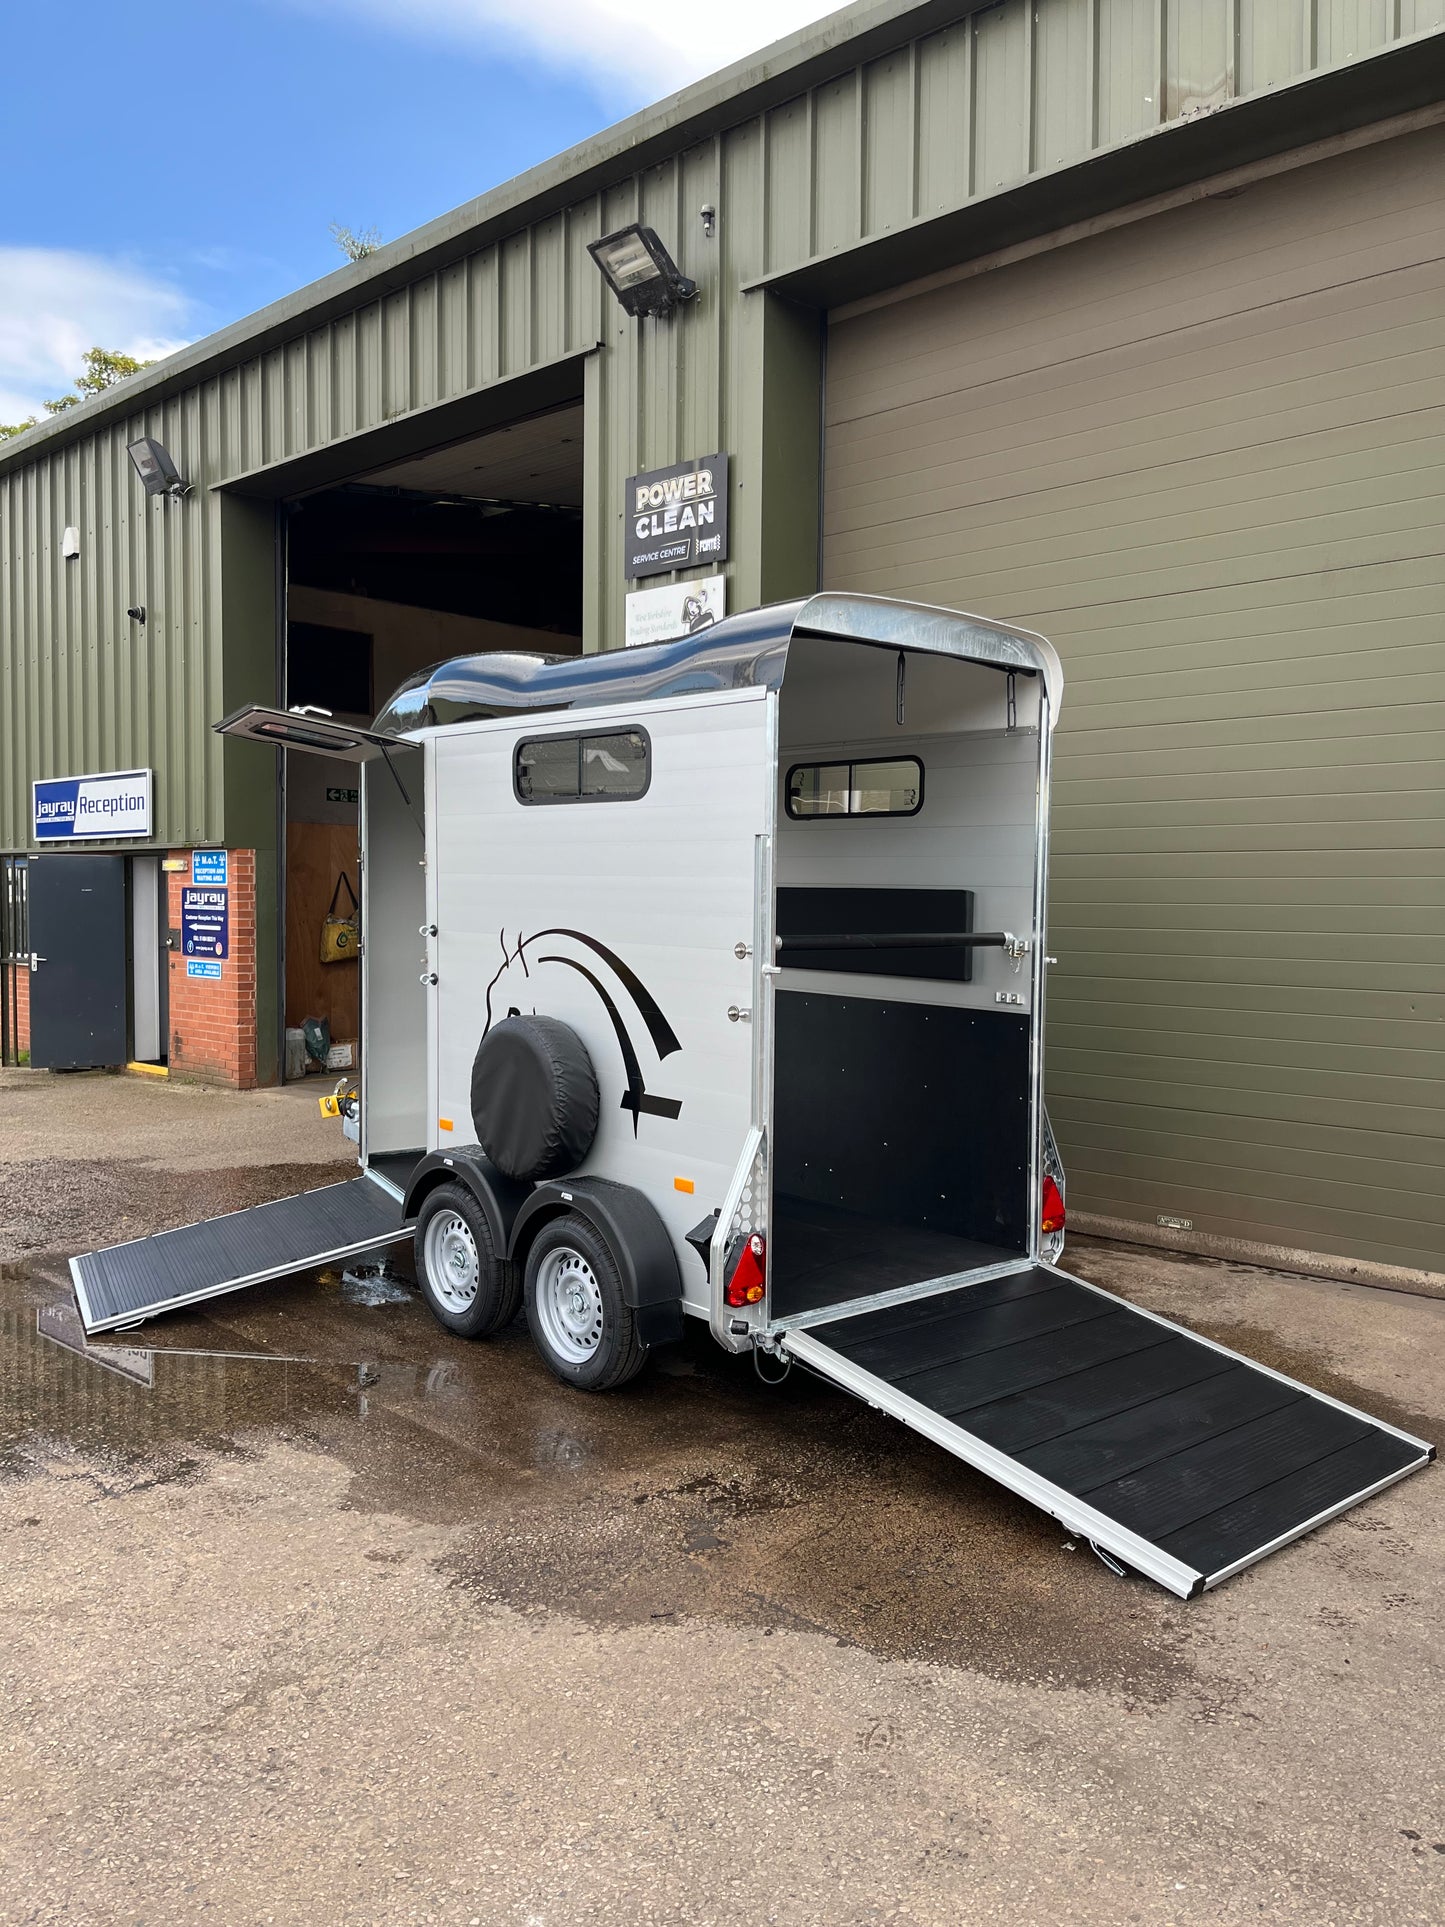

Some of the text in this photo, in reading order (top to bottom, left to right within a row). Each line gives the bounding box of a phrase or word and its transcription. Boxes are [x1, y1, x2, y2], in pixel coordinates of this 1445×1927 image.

[636, 470, 714, 512] POWER
[636, 501, 714, 539] CLEAN
[632, 545, 686, 565] SERVICE CENTRE
[36, 800, 75, 817] jayray
[79, 793, 145, 816] Reception
[184, 890, 225, 906] jayray
